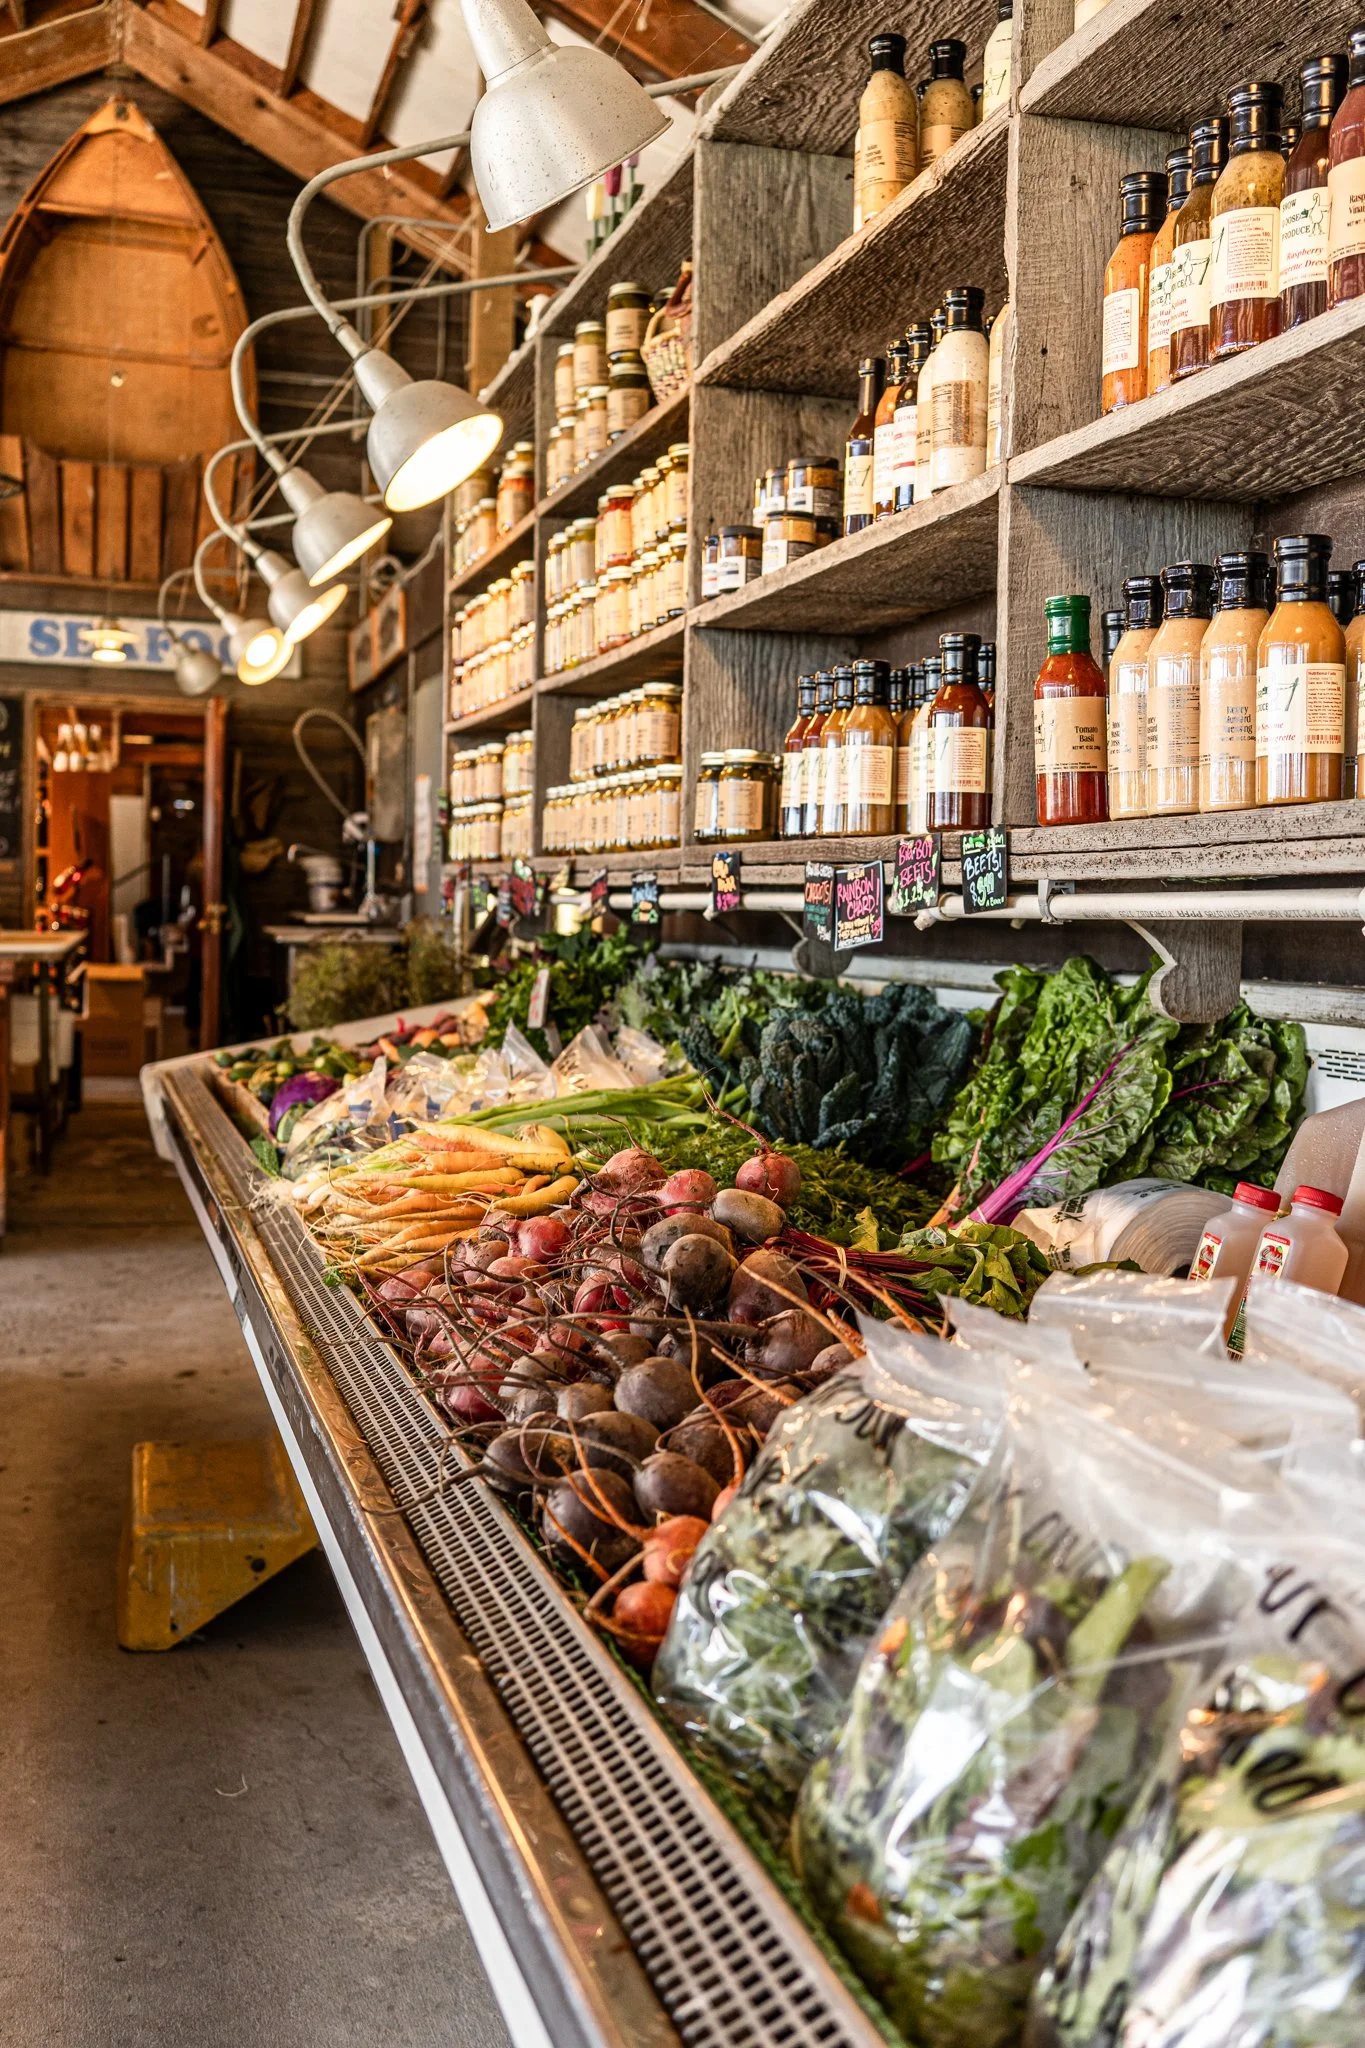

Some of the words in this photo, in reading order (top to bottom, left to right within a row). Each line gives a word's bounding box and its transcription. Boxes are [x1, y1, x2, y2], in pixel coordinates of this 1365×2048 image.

[1281, 225, 1311, 242] PRODUCE
[1286, 246, 1324, 261] Raspberry
[1074, 726, 1099, 734] Tomato
[1079, 734, 1095, 742] Basil
[915, 839, 933, 860] BOY
[900, 851, 938, 888] BEETS!
[963, 852, 1003, 880] BEETS!
[837, 868, 874, 907] RAINBOW
